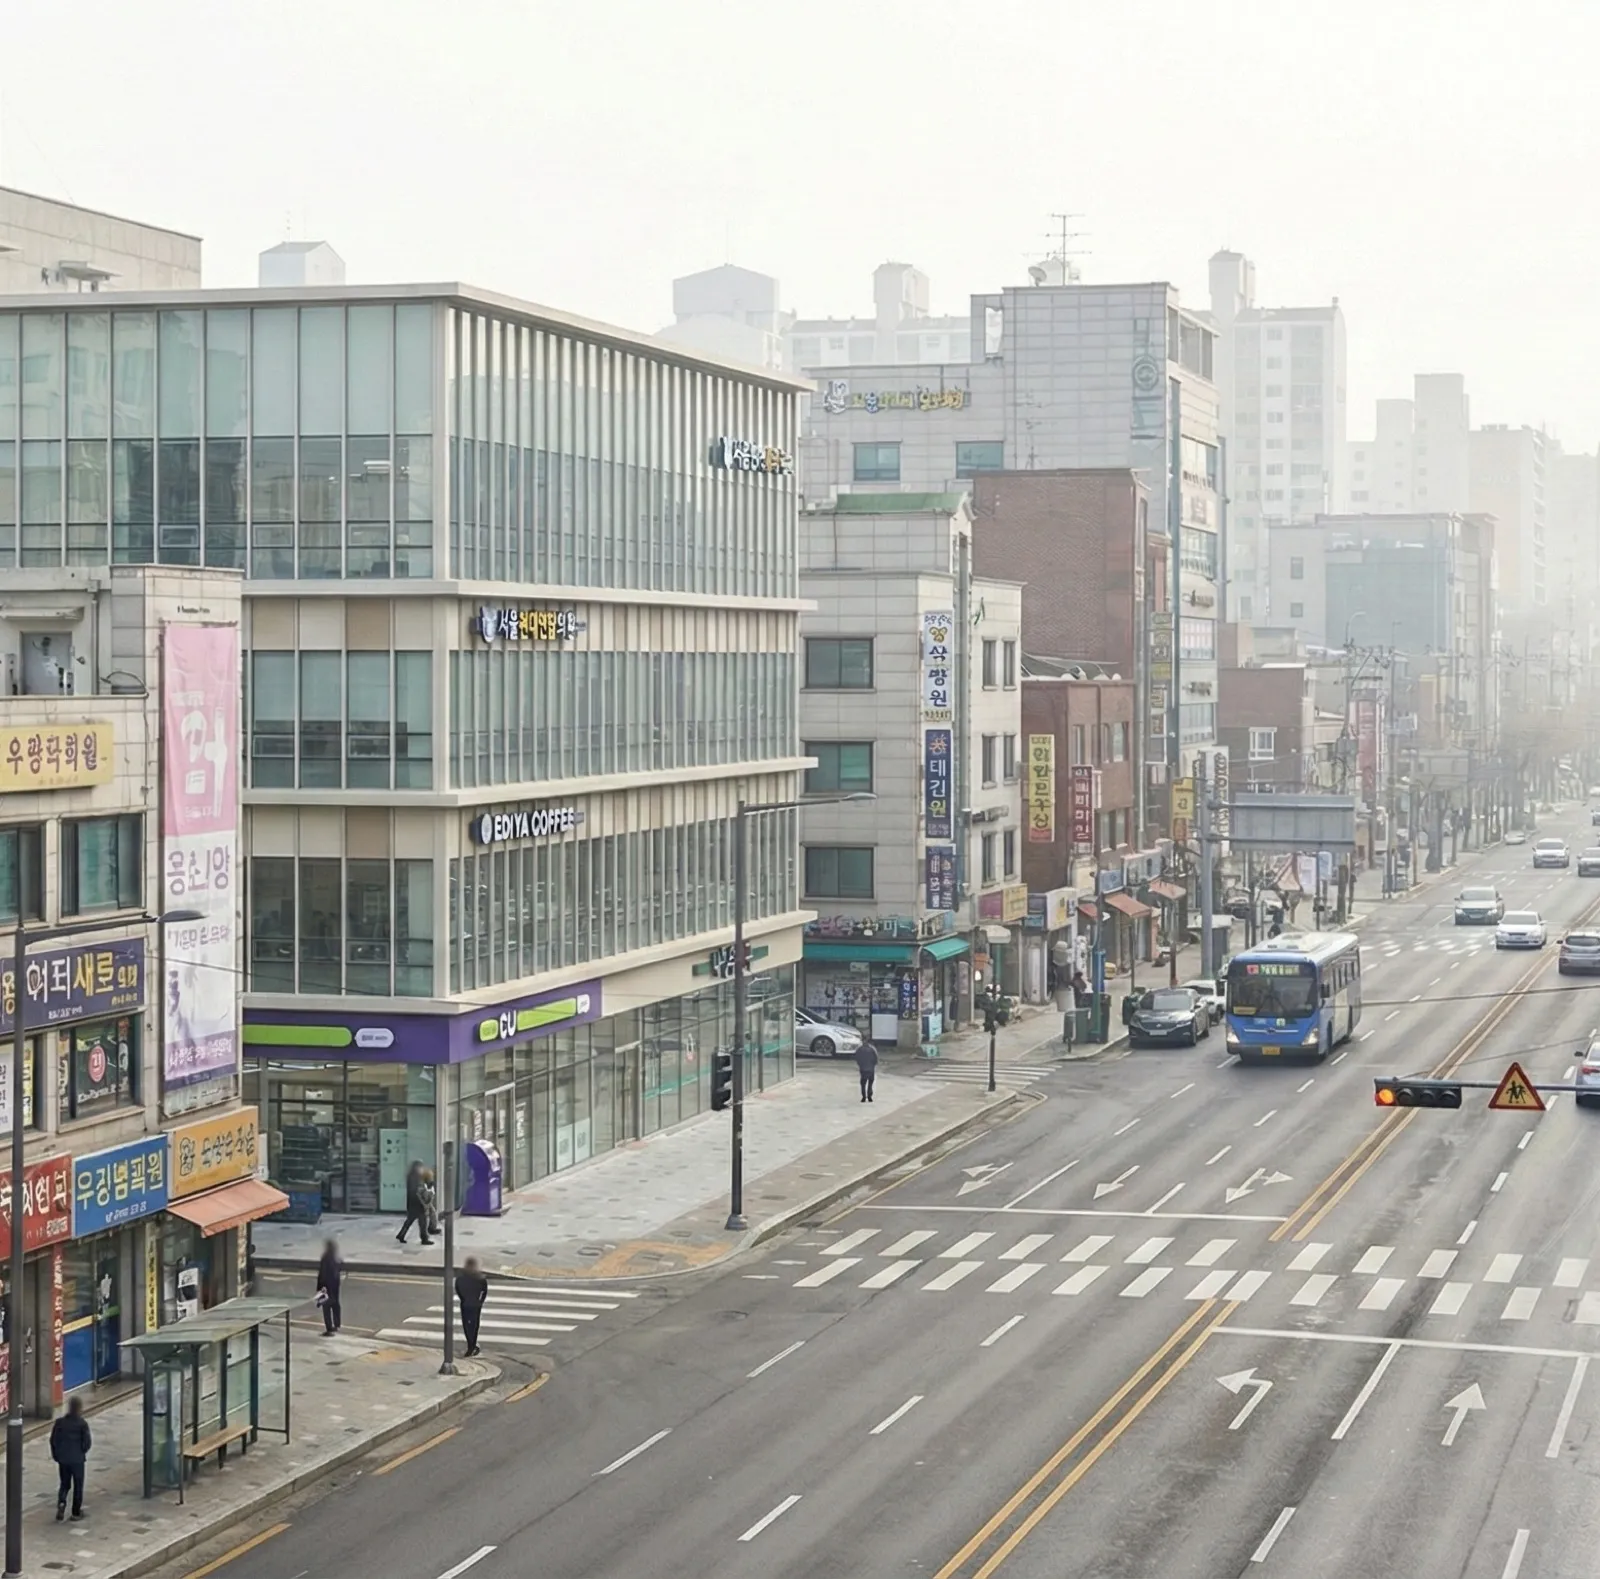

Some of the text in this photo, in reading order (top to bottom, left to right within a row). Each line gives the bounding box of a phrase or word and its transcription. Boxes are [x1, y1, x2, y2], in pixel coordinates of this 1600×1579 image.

[494, 807, 575, 842] EDIYA COFFEE
[500, 1010, 517, 1040] CU
